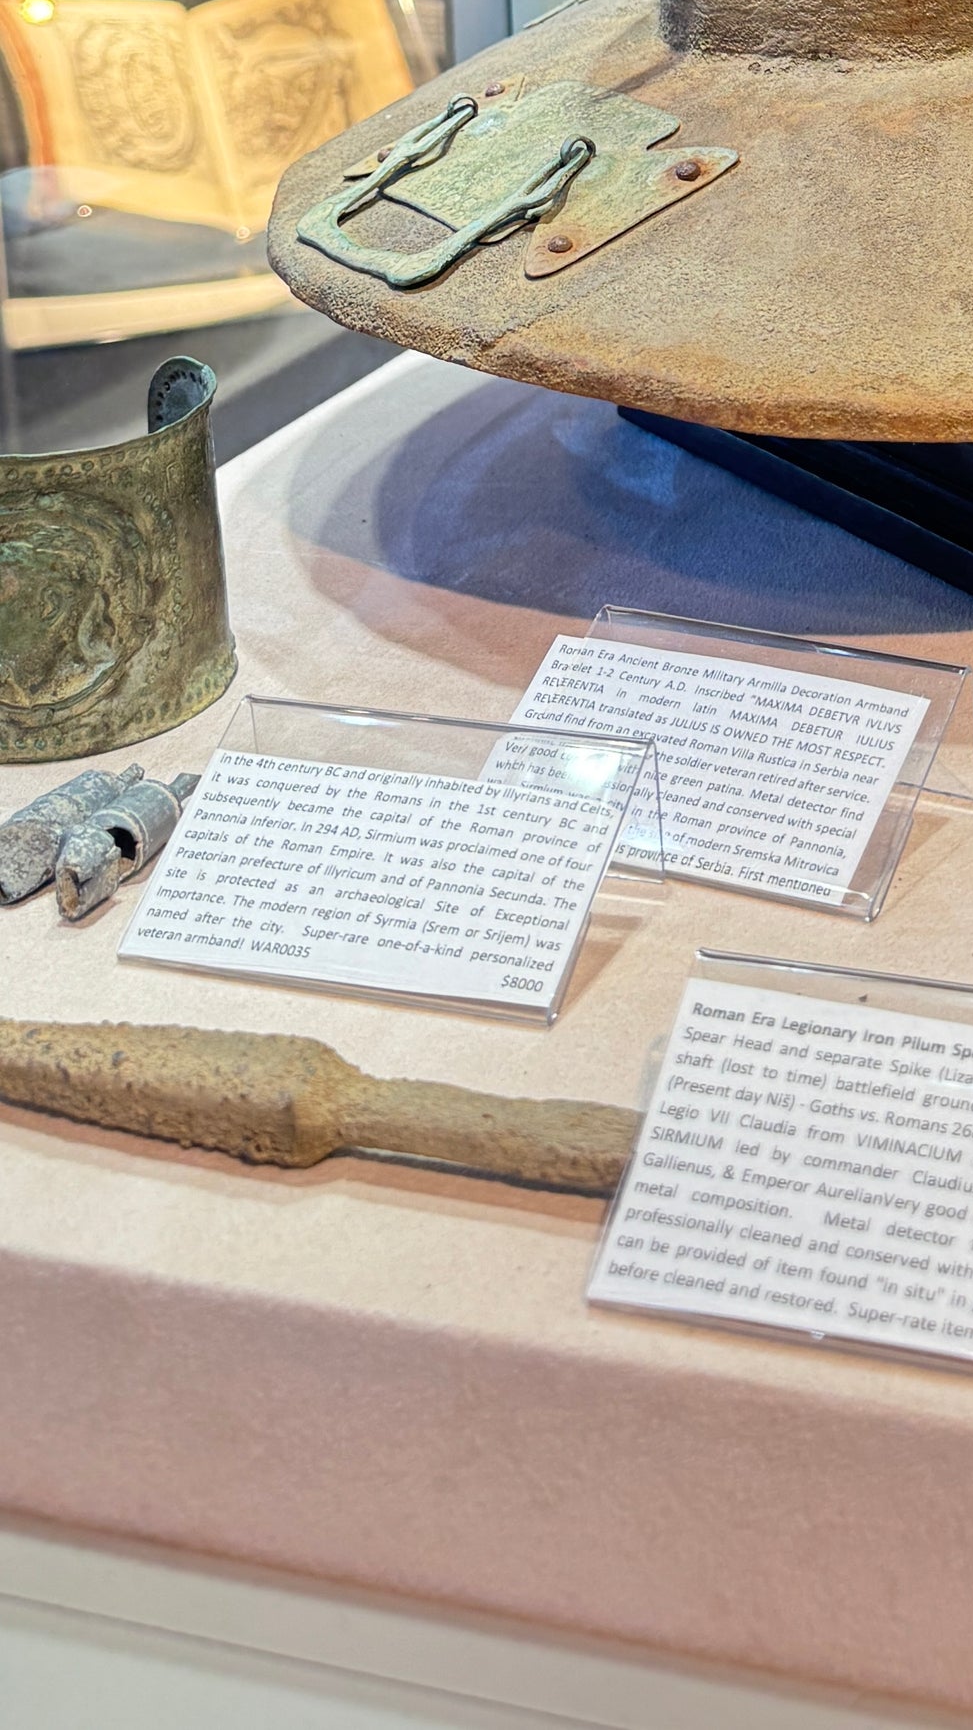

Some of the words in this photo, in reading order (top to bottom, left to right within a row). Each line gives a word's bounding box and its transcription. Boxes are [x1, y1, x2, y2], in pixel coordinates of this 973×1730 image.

[549, 658, 593, 674] Braelet
[595, 665, 615, 679] 1-2
[617, 669, 662, 689] Century
[663, 679, 687, 693] A.D.
[693, 684, 746, 703] Inscribed
[807, 705, 861, 726] DEBETVR
[864, 717, 903, 735] IVLIVS
[596, 648, 616, 661] Era
[616, 652, 659, 670] Ancient
[660, 660, 700, 677] Bronze
[701, 668, 745, 687] Military
[745, 676, 787, 694] Armilla
[789, 684, 852, 706] Decoration
[853, 697, 910, 718] Armband
[597, 702, 655, 722] translated
[653, 714, 669, 725] as
[668, 716, 709, 732] JULIUS
[708, 723, 722, 735] IS
[721, 725, 769, 744] OWNED
[770, 734, 795, 749] THE
[794, 739, 833, 756] MOST
[831, 747, 885, 769] RESPECT.
[614, 686, 628, 699] in
[637, 693, 681, 709] modern
[691, 701, 718, 716] latin
[728, 708, 778, 728] MAXIMA
[789, 720, 844, 741] DEBETUR
[854, 733, 895, 751] IULIUS
[226, 774, 251, 787] was
[255, 778, 321, 794] conquered
[324, 783, 342, 799] by
[345, 786, 368, 800] the
[373, 789, 423, 807] Romans
[427, 796, 442, 809] in
[447, 799, 470, 813] the
[475, 802, 497, 817] 1st
[501, 808, 552, 828] century
[557, 816, 578, 830] BC
[581, 823, 610, 836] and
[232, 755, 254, 768] the
[254, 757, 276, 770] 4th
[276, 761, 324, 778] century
[323, 765, 342, 778] BC
[341, 769, 367, 781] and
[366, 772, 423, 789] originally
[423, 778, 484, 795] inhabited
[483, 785, 502, 799] by
[501, 787, 552, 806] Illyrians
[552, 798, 579, 811] and
[579, 801, 620, 819] Celts,
[643, 768, 668, 783] nice
[668, 774, 704, 789] green
[704, 781, 744, 797] patina.
[748, 788, 785, 804] Metal
[785, 795, 838, 815] detector
[838, 806, 865, 822] find
[655, 789, 702, 808] cleaned
[700, 799, 726, 812] and
[725, 804, 786, 824] conserved
[786, 816, 814, 831] with
[813, 823, 858, 840] special
[192, 807, 248, 825] Pannonia
[249, 814, 297, 832] Inferior.
[299, 820, 313, 833] In
[313, 822, 340, 836] 294
[339, 825, 362, 841] AD,
[363, 827, 417, 846] Sirmium
[418, 837, 445, 850] was
[444, 840, 519, 859] proclaimed
[519, 851, 546, 865] one
[546, 854, 565, 867] of
[564, 856, 594, 872] four
[201, 790, 281, 811] subsequently
[286, 799, 335, 816] became
[340, 805, 363, 819] the
[368, 810, 413, 825] capital
[417, 814, 435, 827] of
[439, 817, 462, 831] the
[468, 821, 514, 839] Roman
[520, 831, 578, 850] province
[585, 841, 603, 854] of
[629, 804, 643, 817] in
[646, 807, 668, 821] the
[671, 810, 713, 830] Roman
[715, 822, 767, 841] province
[770, 832, 787, 845] of
[788, 835, 846, 860] Pannonia,
[136, 927, 183, 941] veteran
[183, 932, 245, 950] armband!
[249, 939, 311, 959] WAR0035
[145, 906, 190, 921] named
[193, 910, 226, 925] after
[230, 915, 253, 930] the
[258, 919, 284, 936] city.
[301, 924, 369, 945] Super-rare
[376, 937, 464, 958] one-of-a-kind
[468, 950, 555, 972] personalized
[500, 973, 544, 993] $8000
[681, 1025, 728, 1045] Spear
[731, 1033, 774, 1053] Head
[777, 1043, 810, 1059] and
[813, 1049, 883, 1071] separate
[888, 1058, 932, 1079] Spike
[690, 1001, 746, 1023] Roman
[749, 1010, 777, 1028] Era
[780, 1016, 857, 1043] Legionary
[861, 1028, 896, 1047] Iron
[899, 1034, 947, 1055] Pilum
[674, 1050, 715, 1070] shaft
[719, 1056, 756, 1076] (lost
[761, 1064, 779, 1081] to
[785, 1068, 828, 1090] time)
[834, 1075, 916, 1102] battlefield
[649, 1125, 724, 1150] SIRMIUM
[733, 1138, 761, 1157] led
[769, 1144, 792, 1166] by
[802, 1154, 900, 1180] commander
[607, 1259, 660, 1283] before
[662, 1269, 726, 1294] cleaned
[727, 1282, 762, 1300] and
[763, 1290, 837, 1314] restored.
